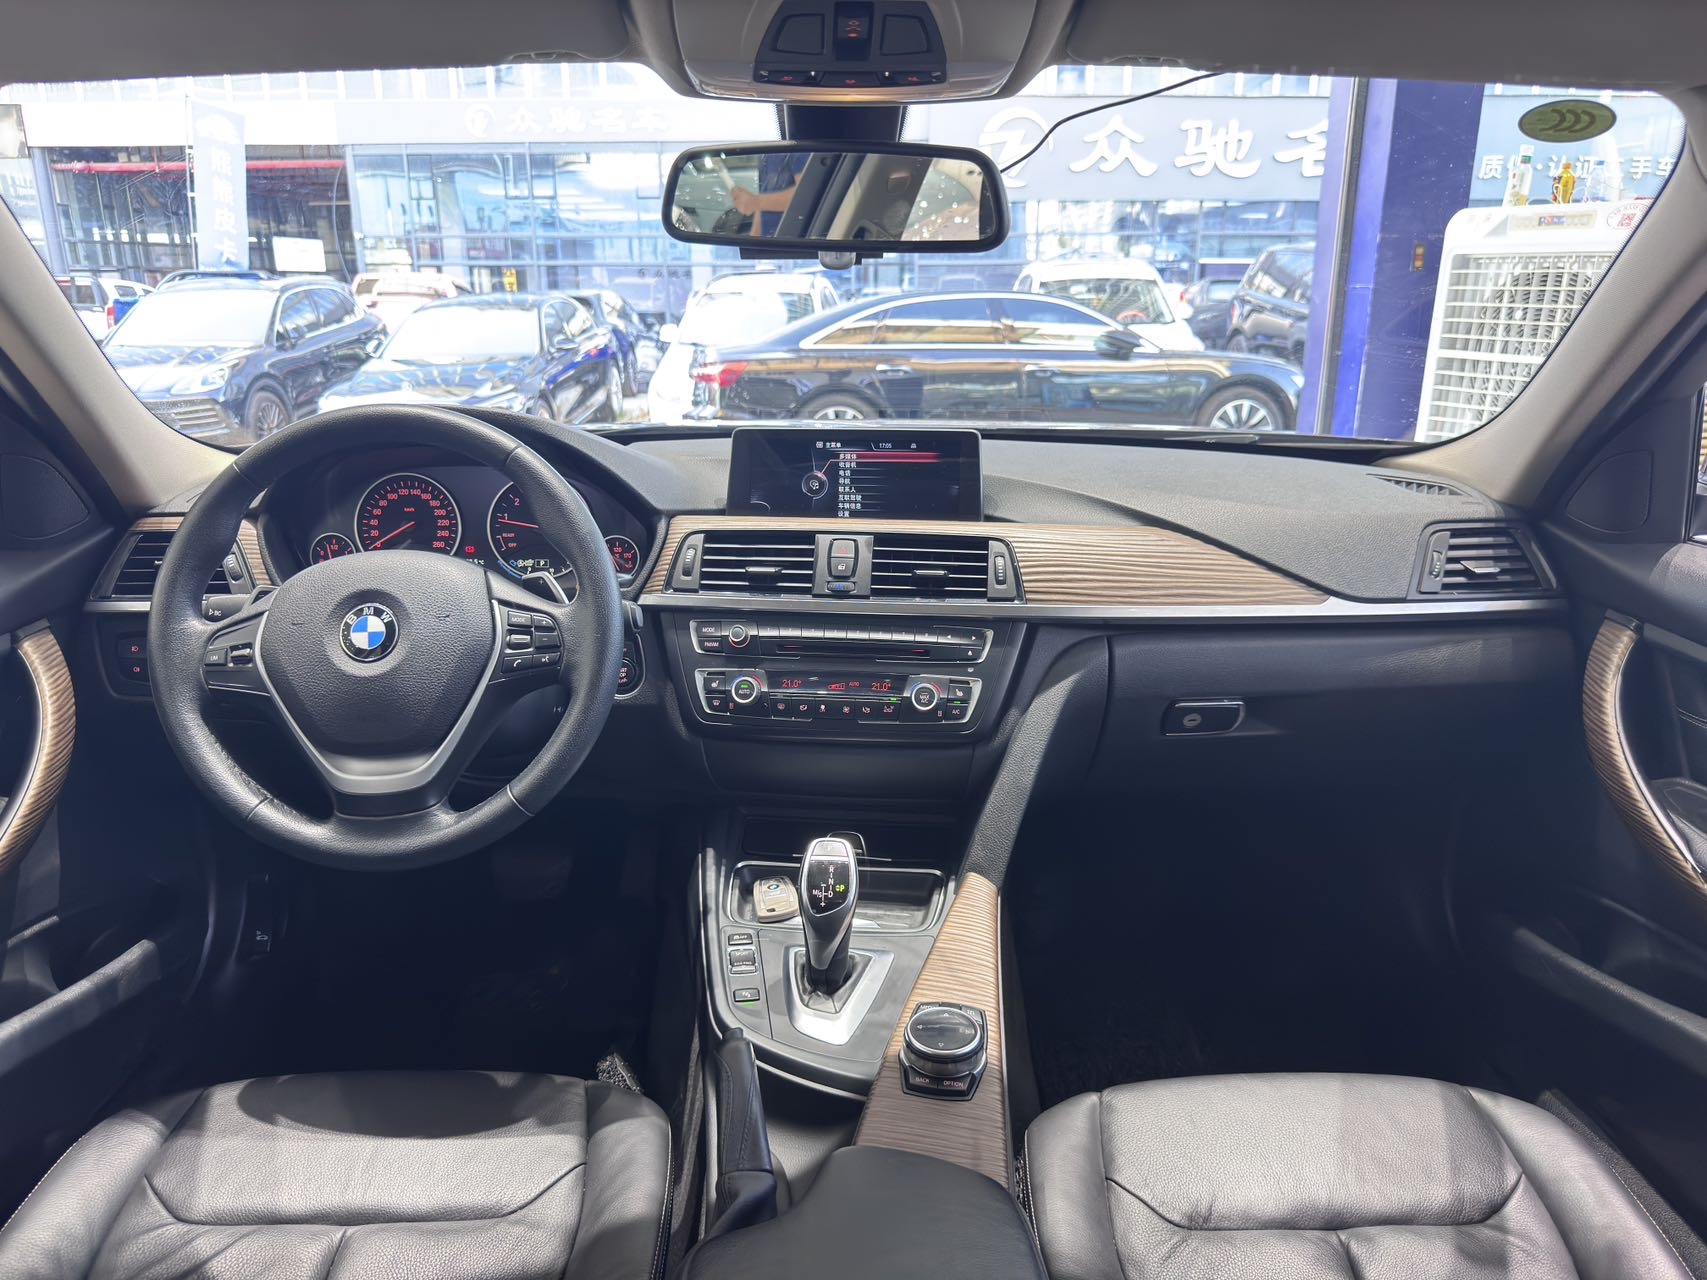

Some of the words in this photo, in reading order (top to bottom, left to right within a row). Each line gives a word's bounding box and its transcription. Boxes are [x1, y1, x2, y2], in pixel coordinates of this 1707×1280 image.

[505, 105, 669, 134] 众驰名车
[372, 508, 382, 516] 60
[346, 606, 392, 625] BMW
[943, 1080, 964, 1088] OPTION
